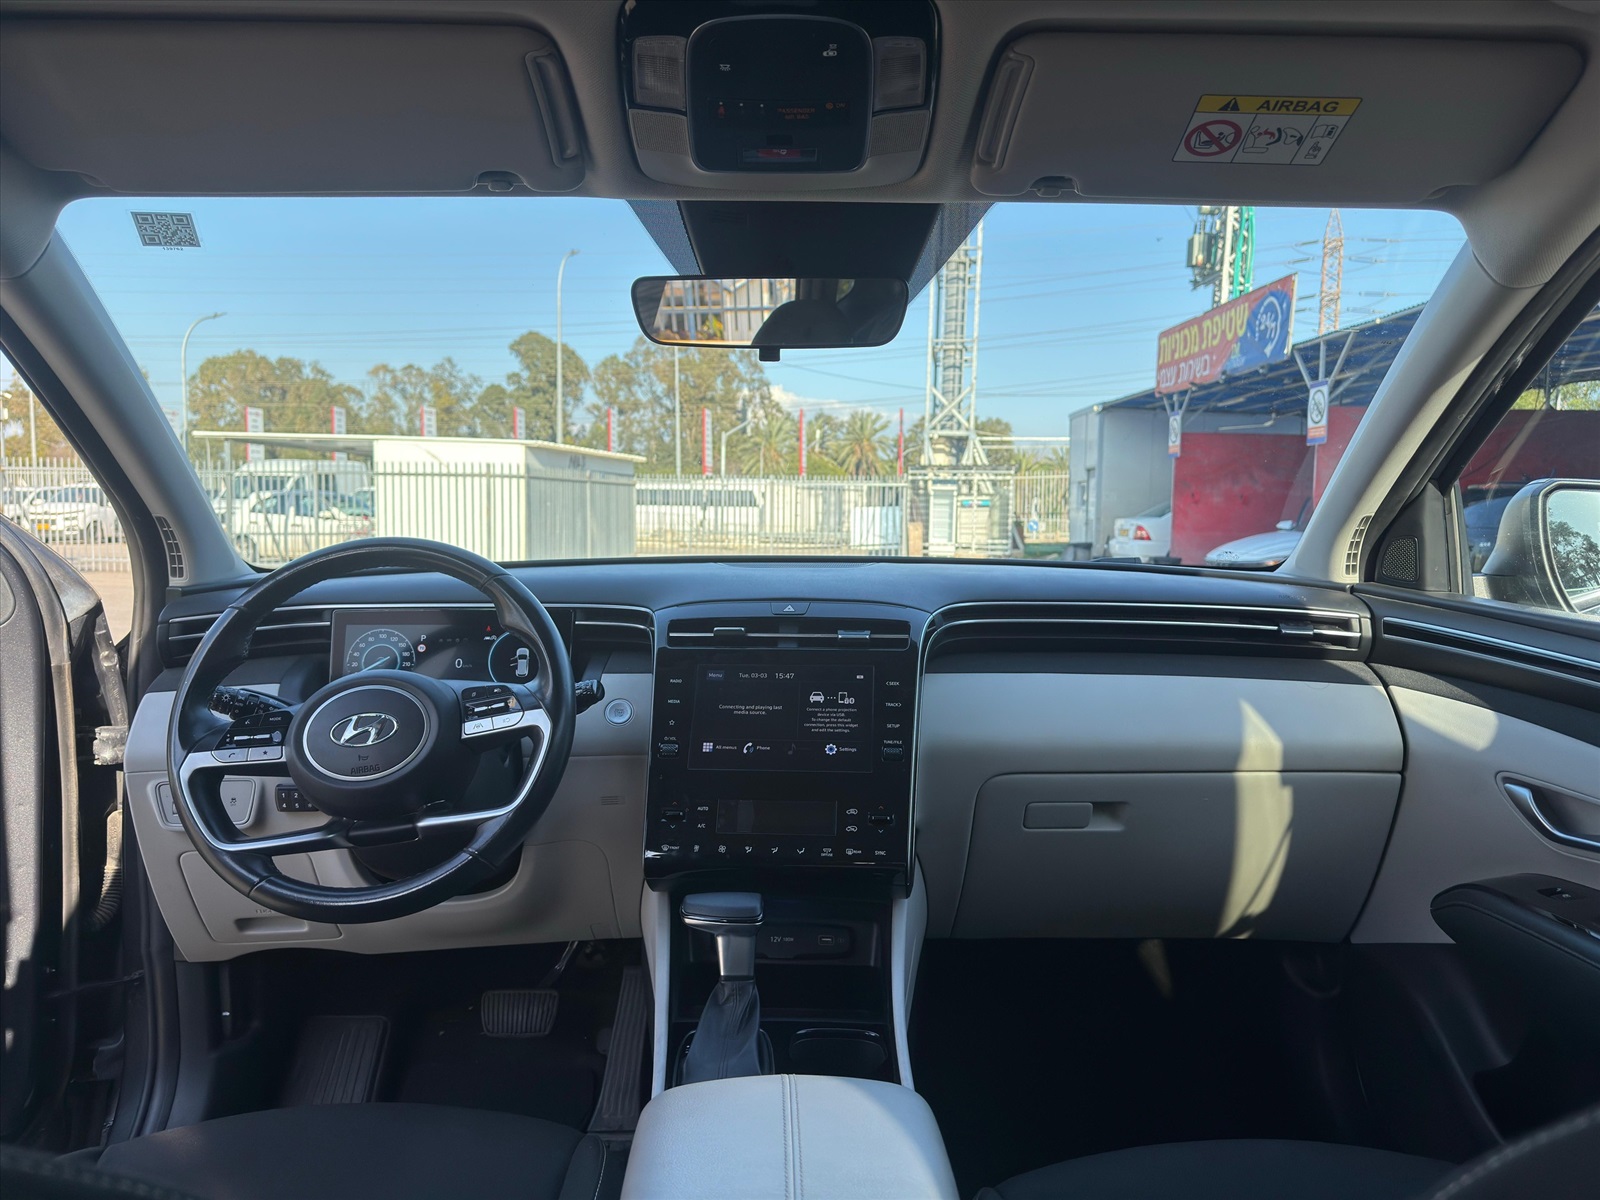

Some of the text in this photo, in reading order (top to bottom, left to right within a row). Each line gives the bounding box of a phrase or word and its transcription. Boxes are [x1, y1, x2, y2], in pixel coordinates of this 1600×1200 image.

[1256, 100, 1340, 113] AIRBAG
[1159, 302, 1249, 366] שטיפת מכוניות
[1178, 354, 1210, 385] בשירות
[420, 634, 427, 642] P
[455, 658, 463, 669] 0
[775, 672, 795, 680] 15:47
[350, 763, 381, 775] AIRBAG
